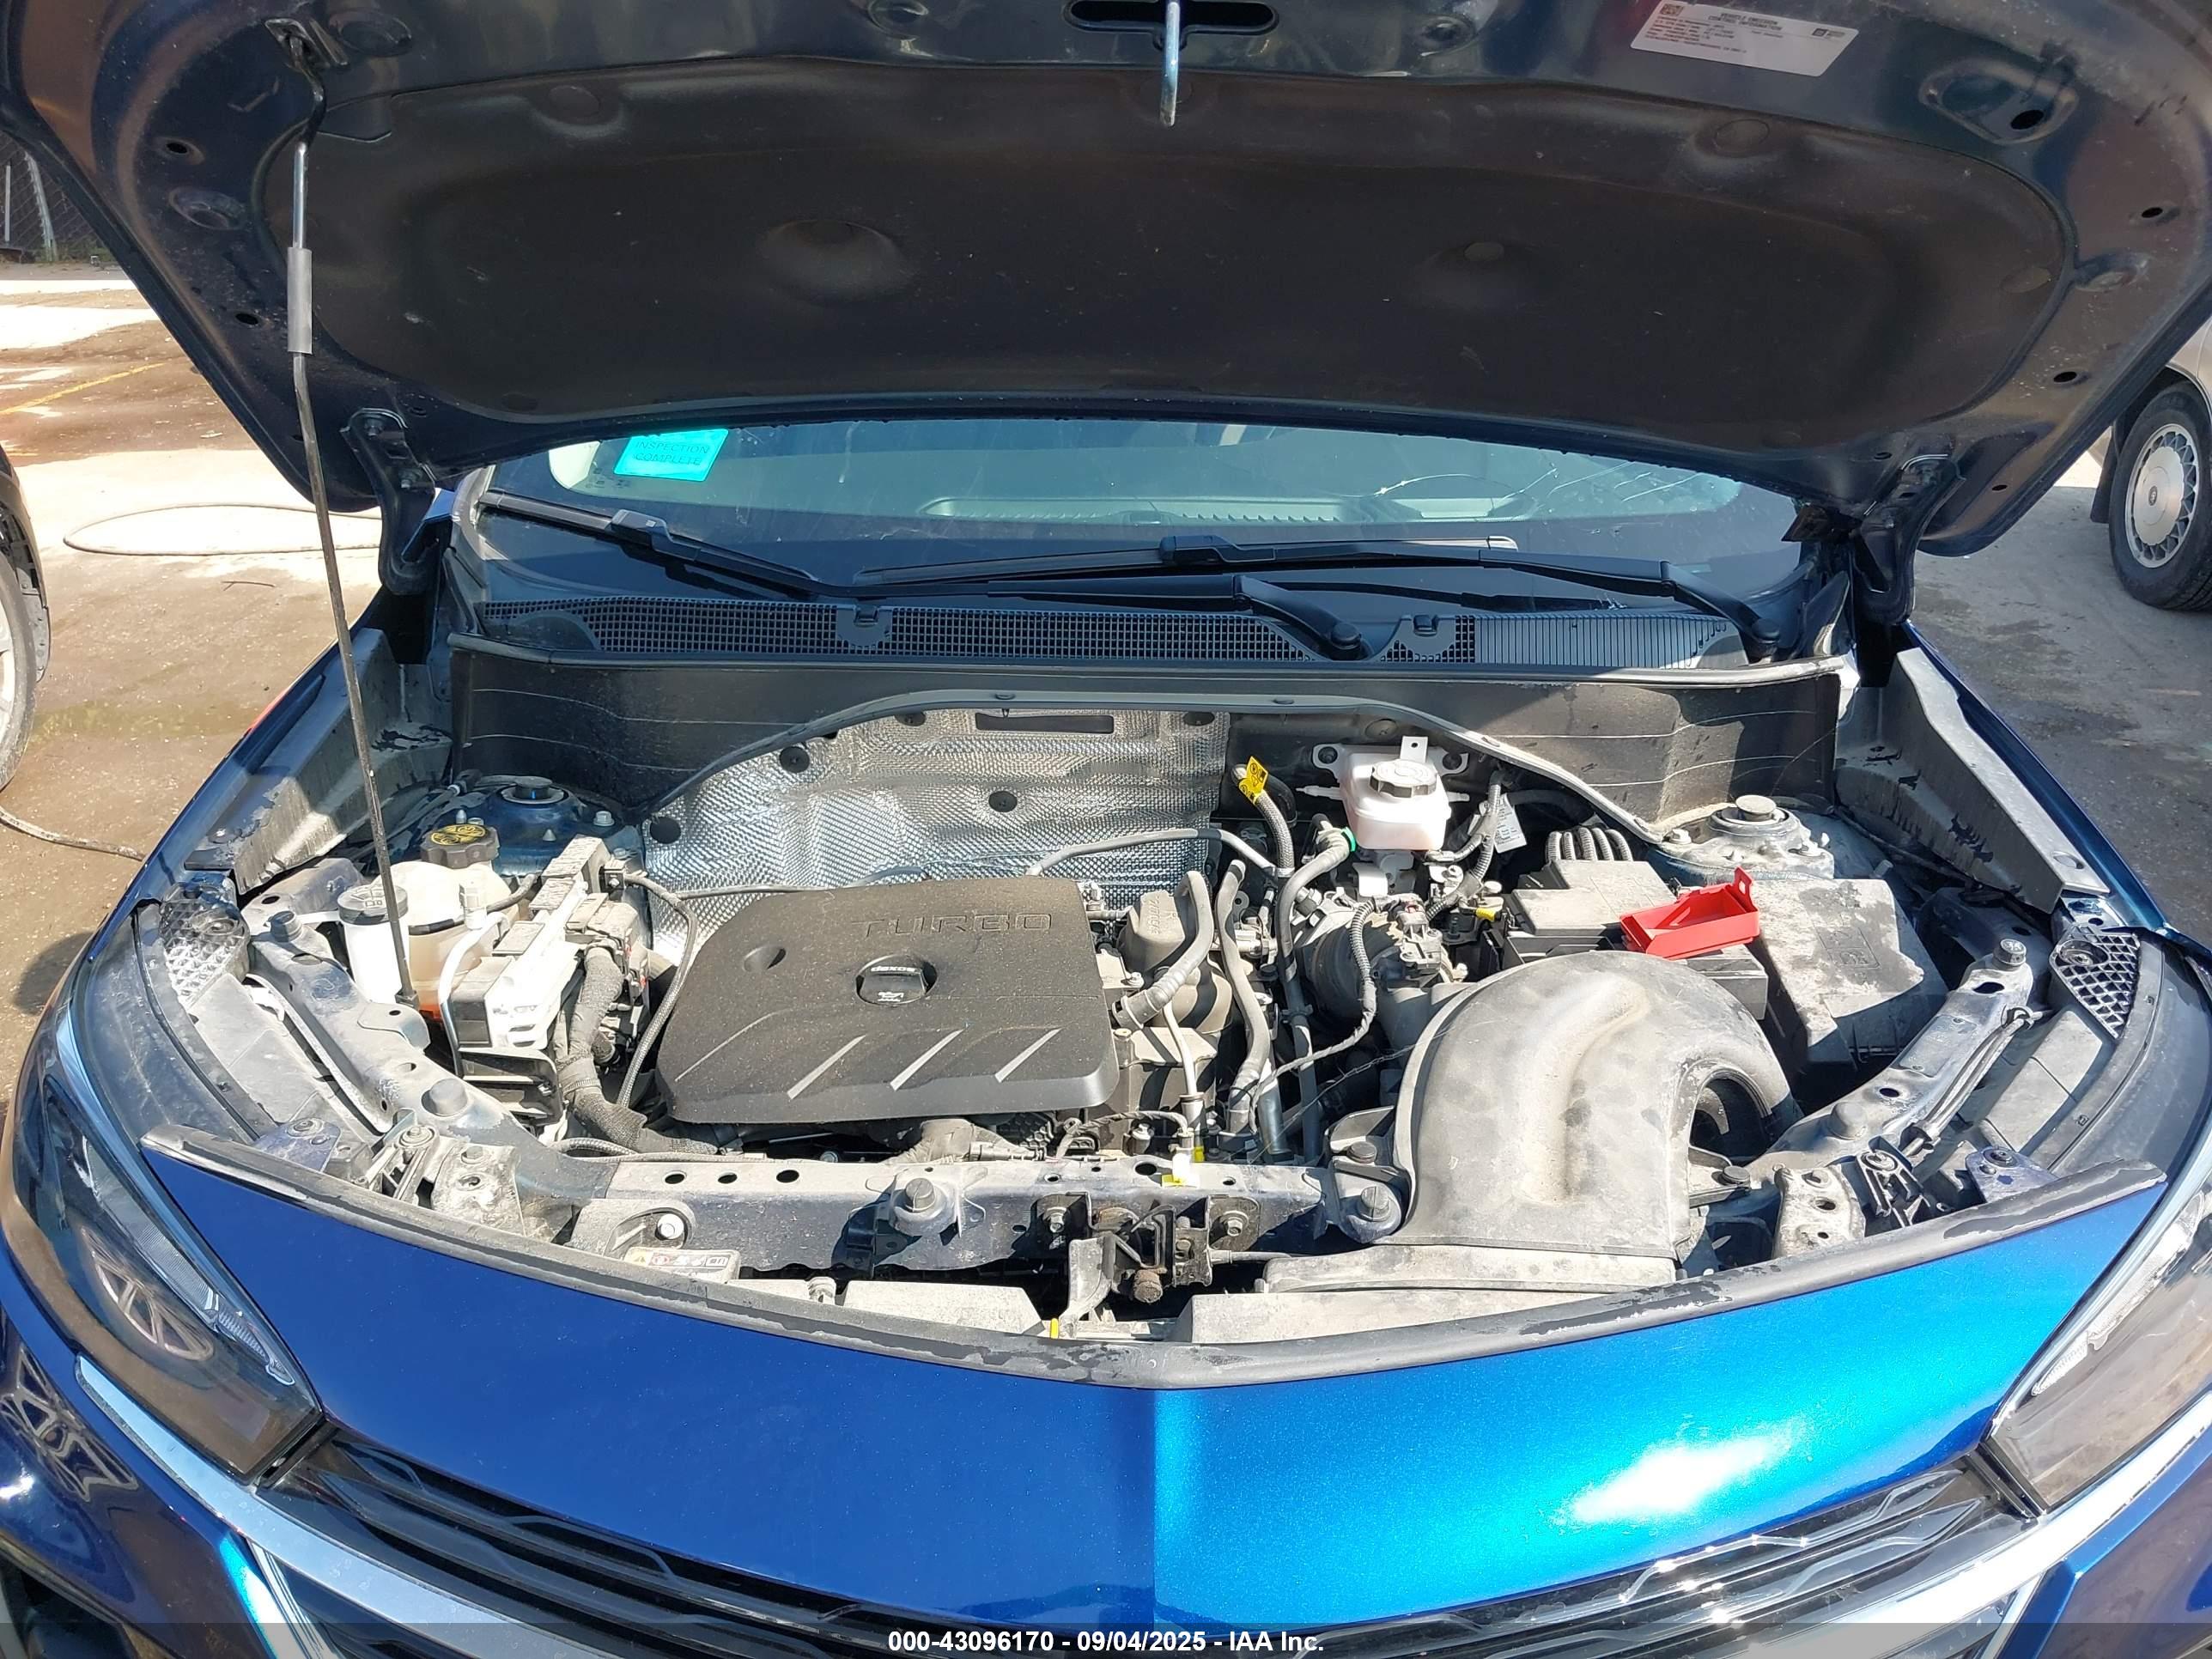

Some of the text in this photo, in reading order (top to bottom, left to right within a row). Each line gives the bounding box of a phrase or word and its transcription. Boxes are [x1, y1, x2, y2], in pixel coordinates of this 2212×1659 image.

[635, 441, 710, 454] INSPECTION
[635, 453, 702, 466] COMPLETE
[851, 913, 1052, 939] TURBO
